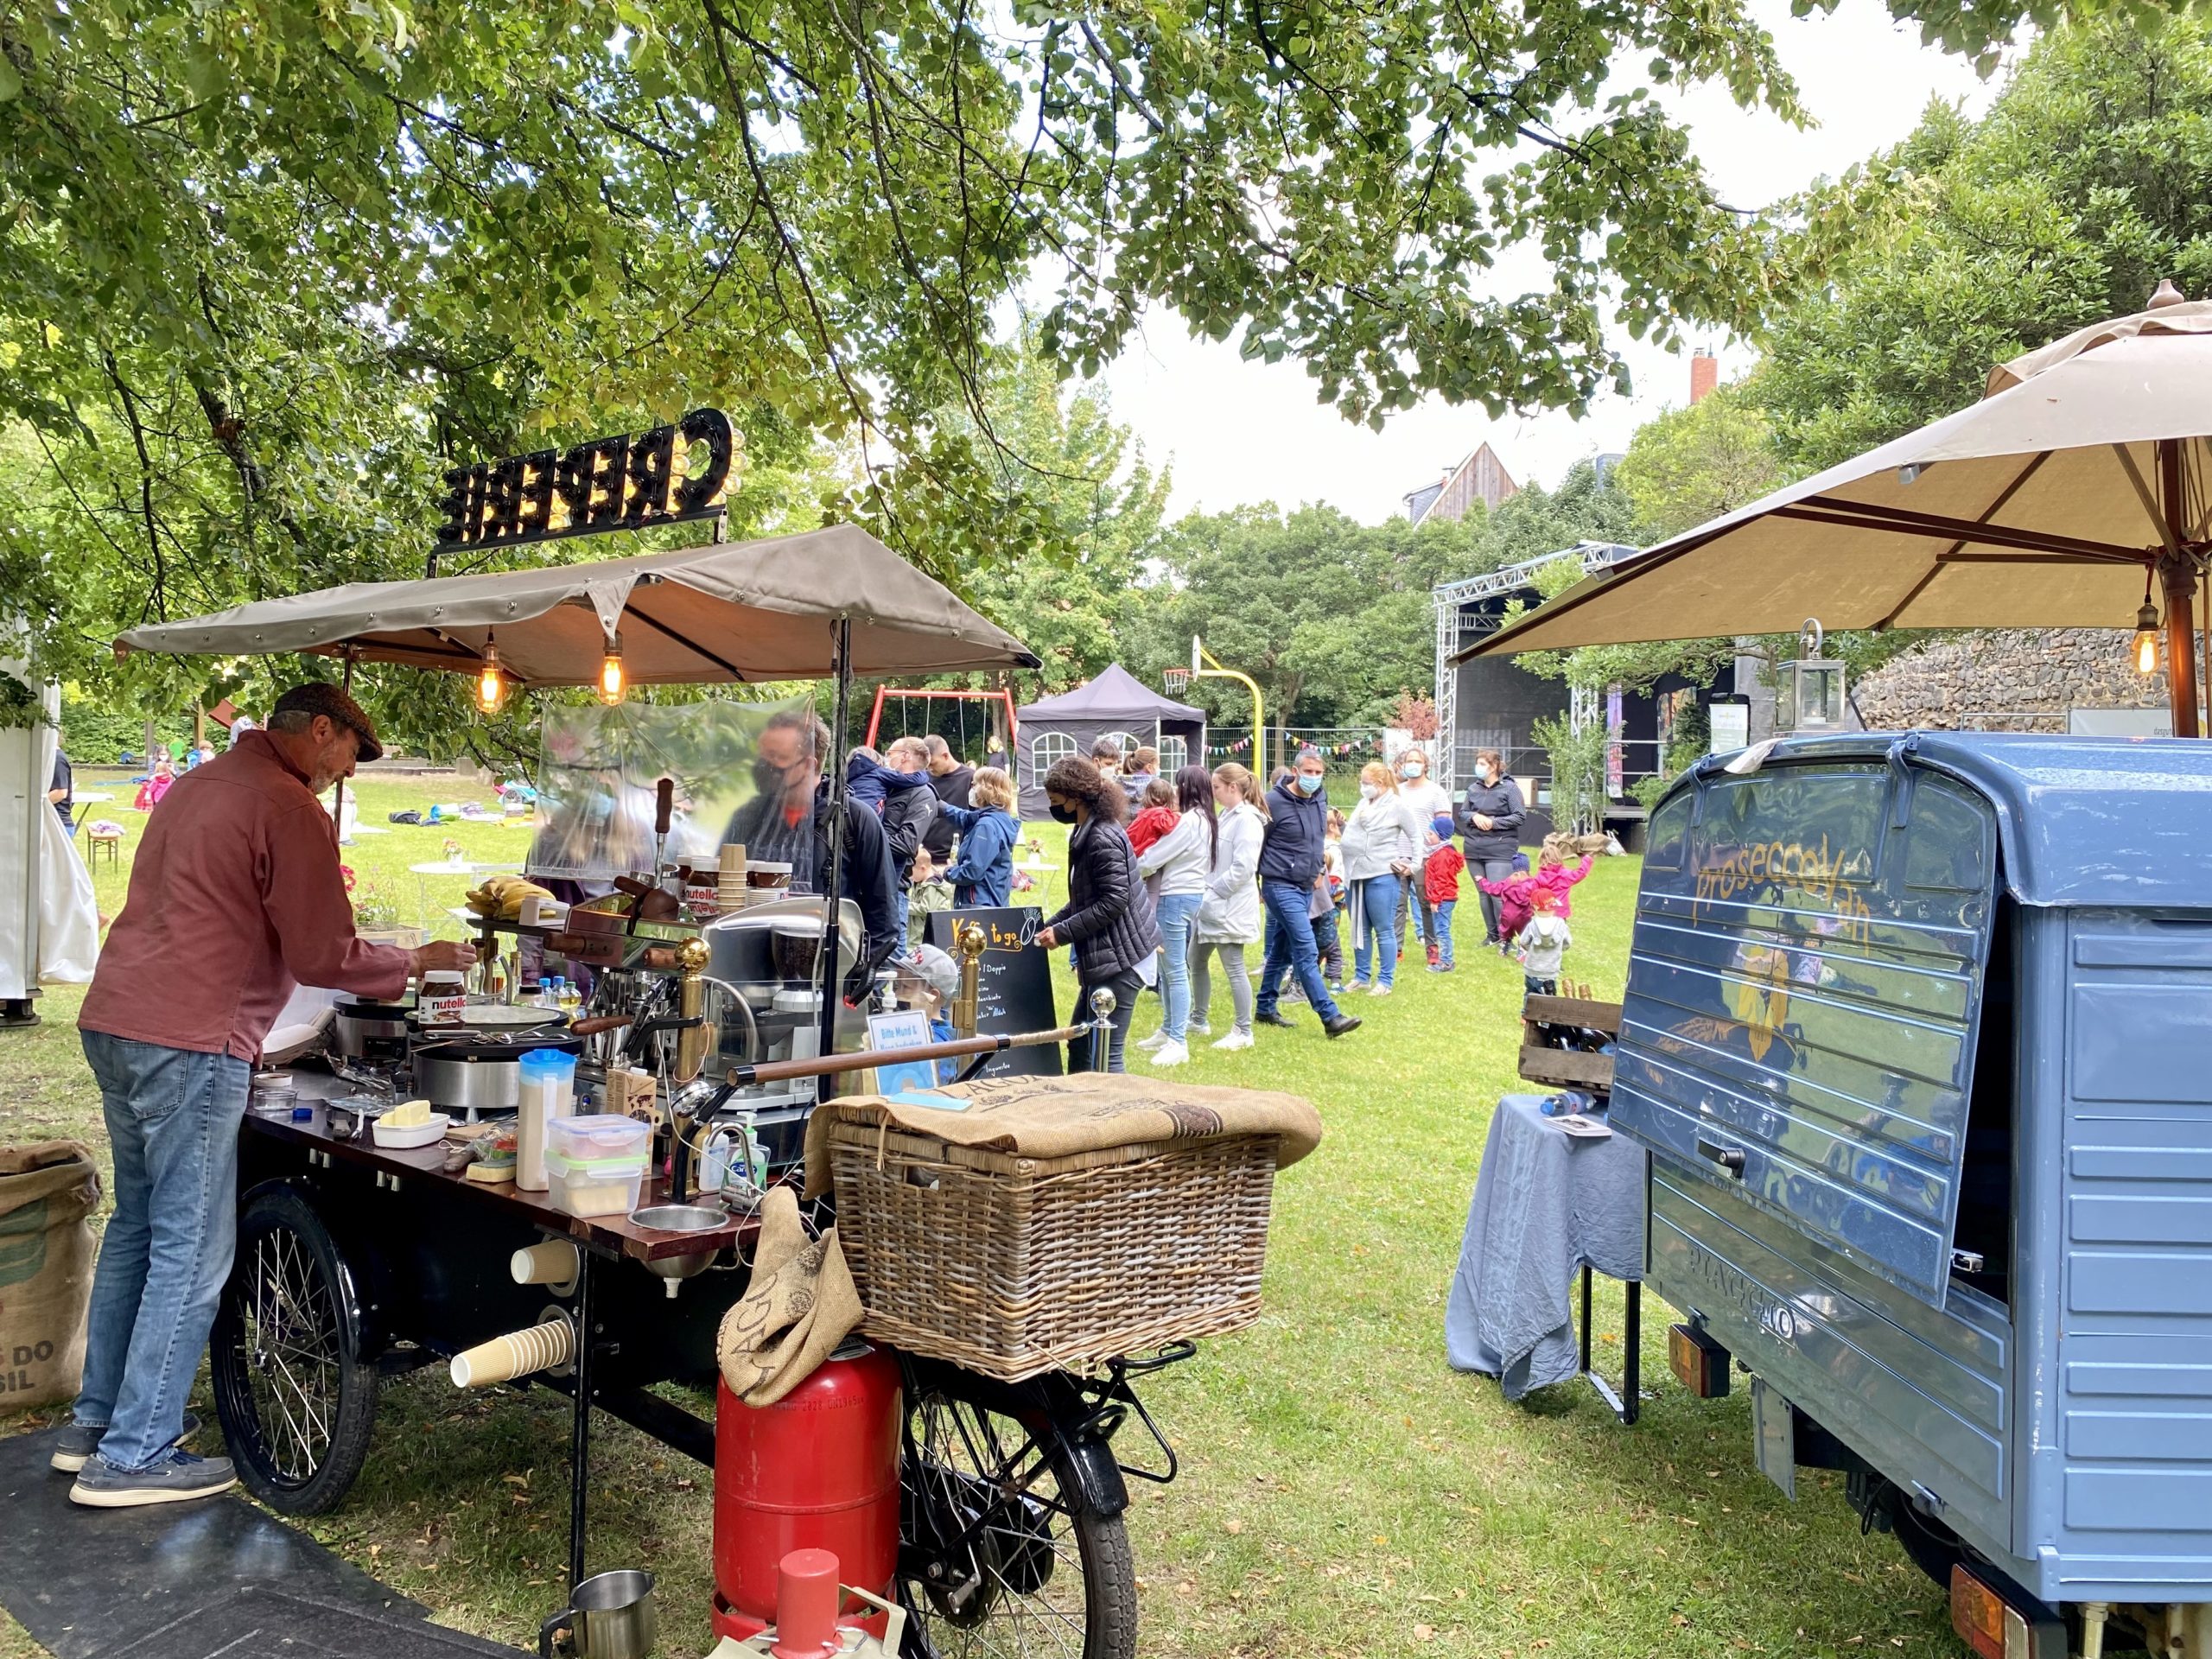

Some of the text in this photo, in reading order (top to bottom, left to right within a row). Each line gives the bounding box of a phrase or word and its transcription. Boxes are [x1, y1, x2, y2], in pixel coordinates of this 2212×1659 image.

[991, 923, 1002, 944] to
[1004, 933, 1017, 946] go
[895, 1025, 912, 1037] Mund
[731, 1164, 758, 1173] Carx
[1688, 1245, 1797, 1341] PIAGGIO
[13, 1340, 54, 1366] DO
